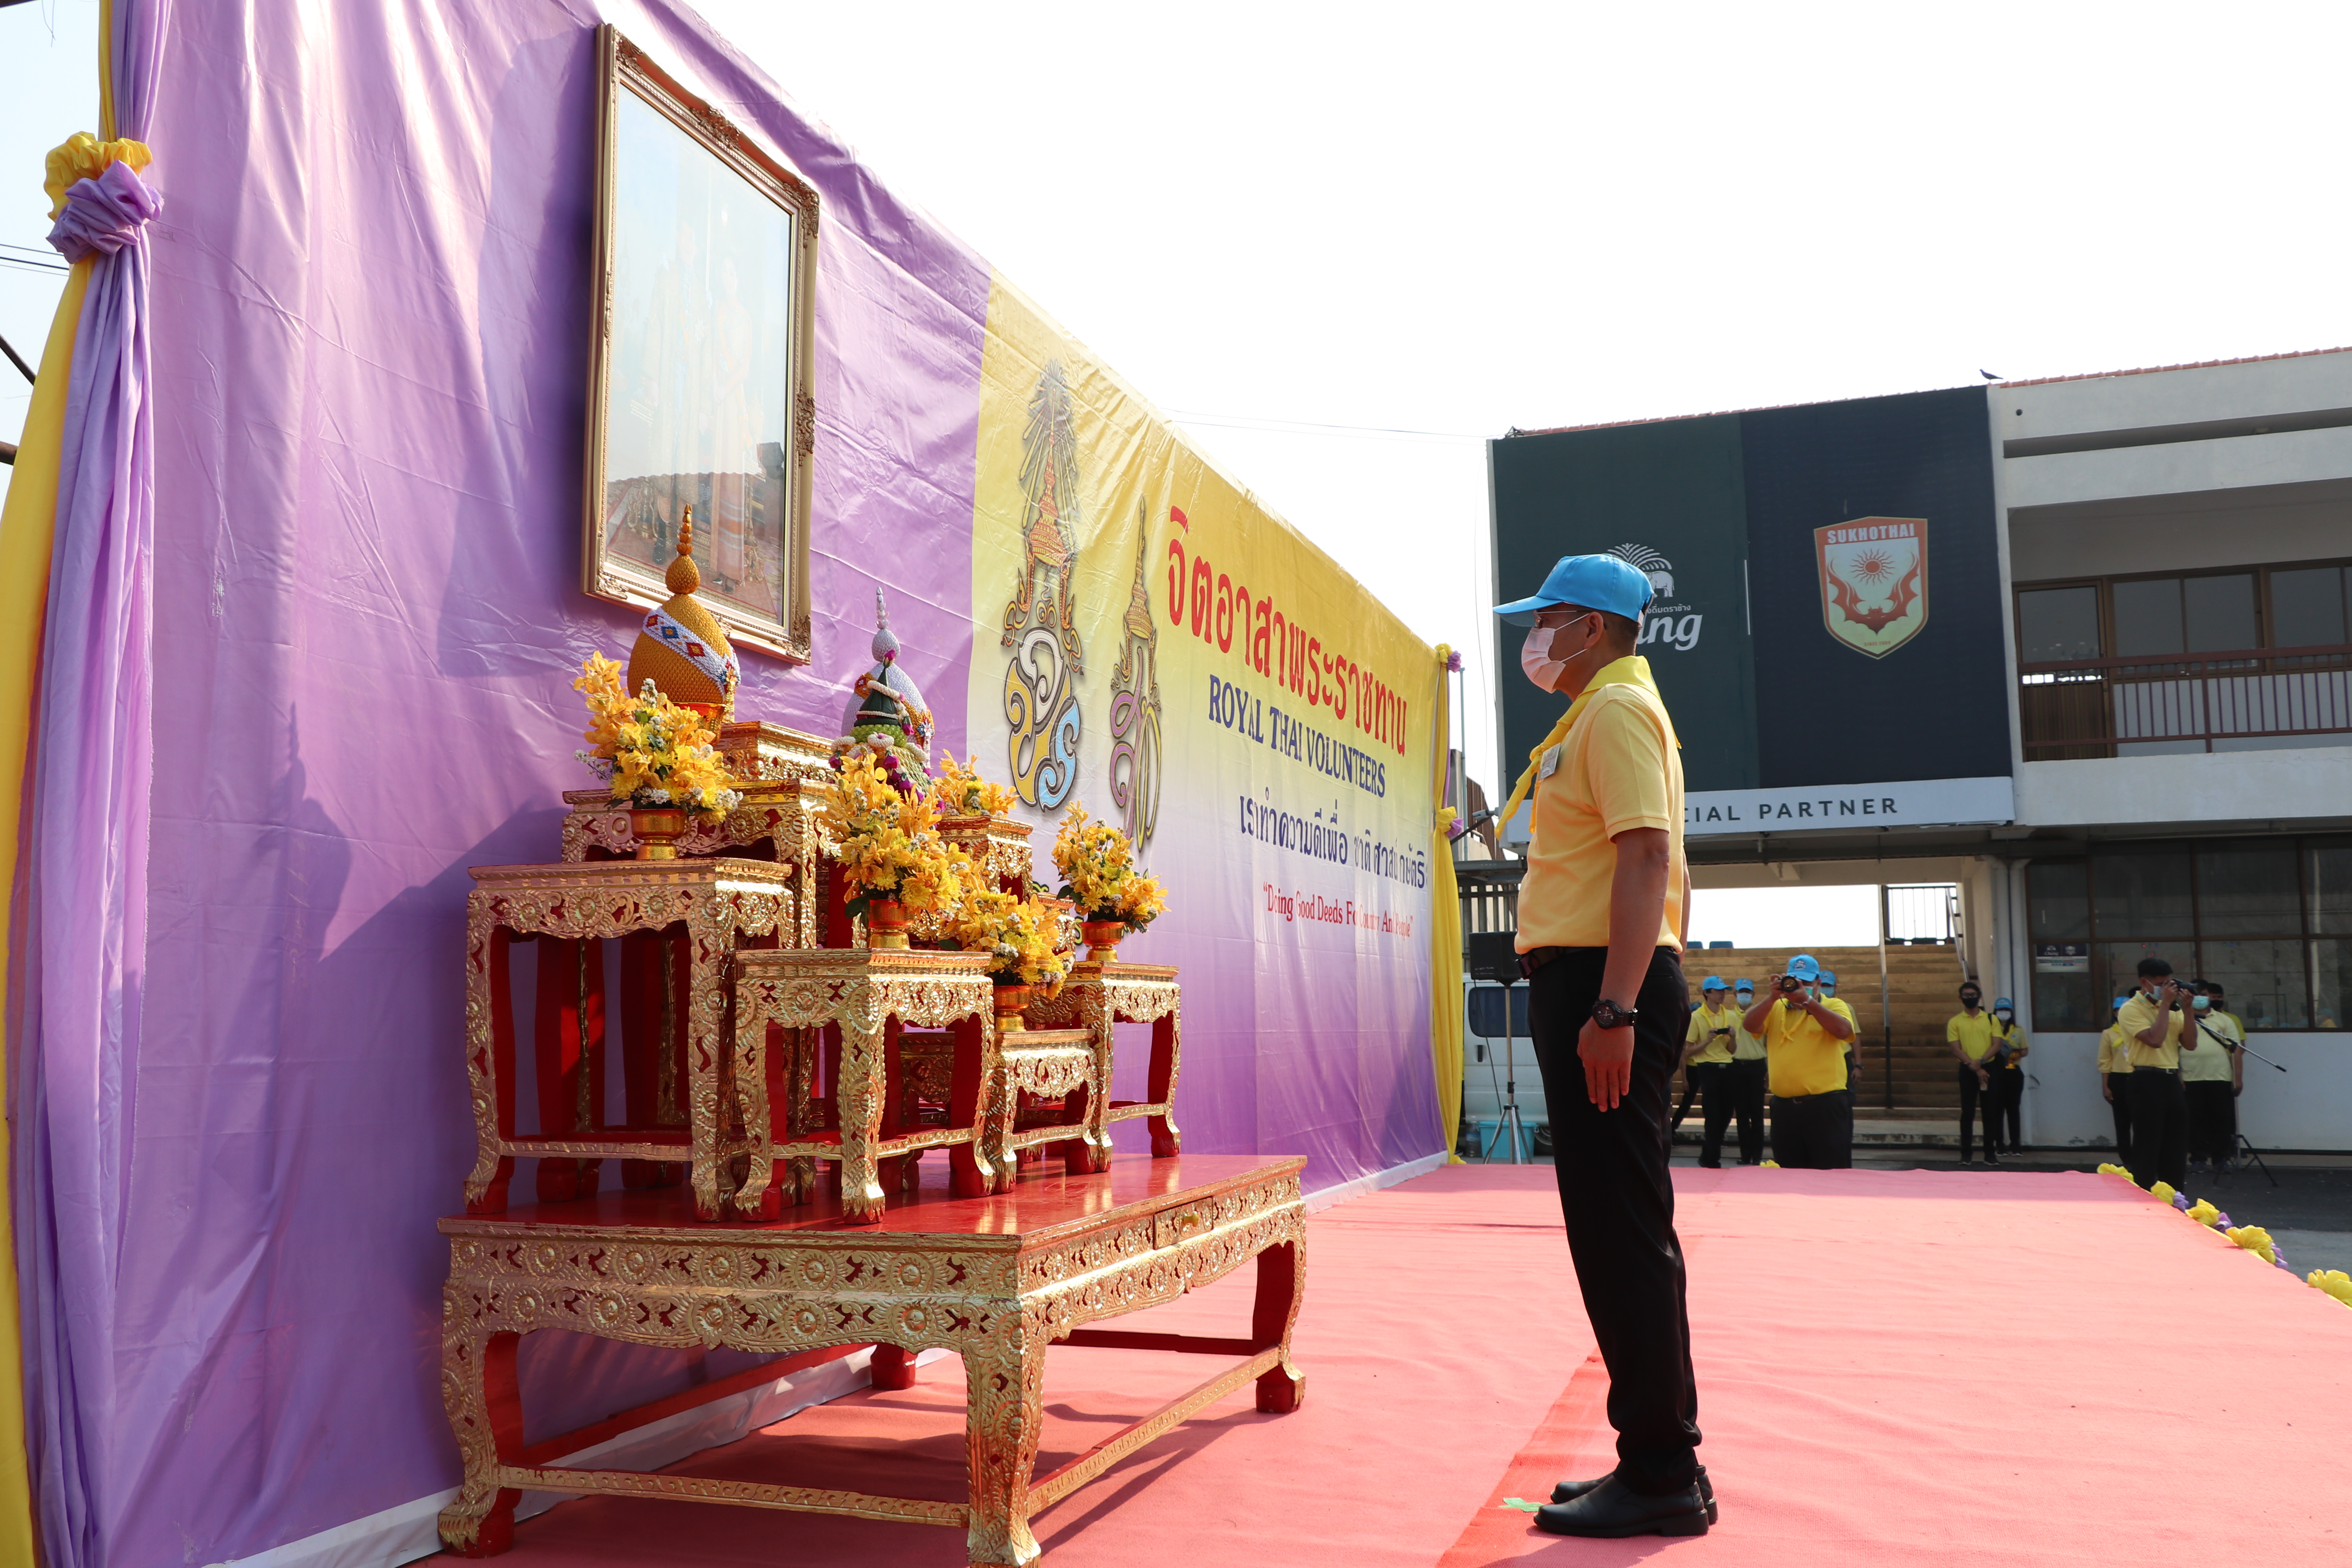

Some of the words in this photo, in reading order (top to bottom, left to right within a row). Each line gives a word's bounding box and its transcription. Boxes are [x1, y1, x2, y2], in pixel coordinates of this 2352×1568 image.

[1827, 523, 1915, 544] SUKHOTHAI
[1169, 505, 1406, 757] จิตอาสาพระราชทาน
[1209, 674, 1264, 744] ROYAL
[1270, 706, 1302, 762] THAI
[1306, 726, 1385, 798] VOLUNTEERS
[1240, 786, 1348, 864] เราทำความดีเพื่อ
[1400, 843, 1428, 889] กษัตริ
[1759, 798, 1897, 819] PARTNER
[1296, 891, 1315, 920] Good
[1318, 896, 1343, 924] Deeds
